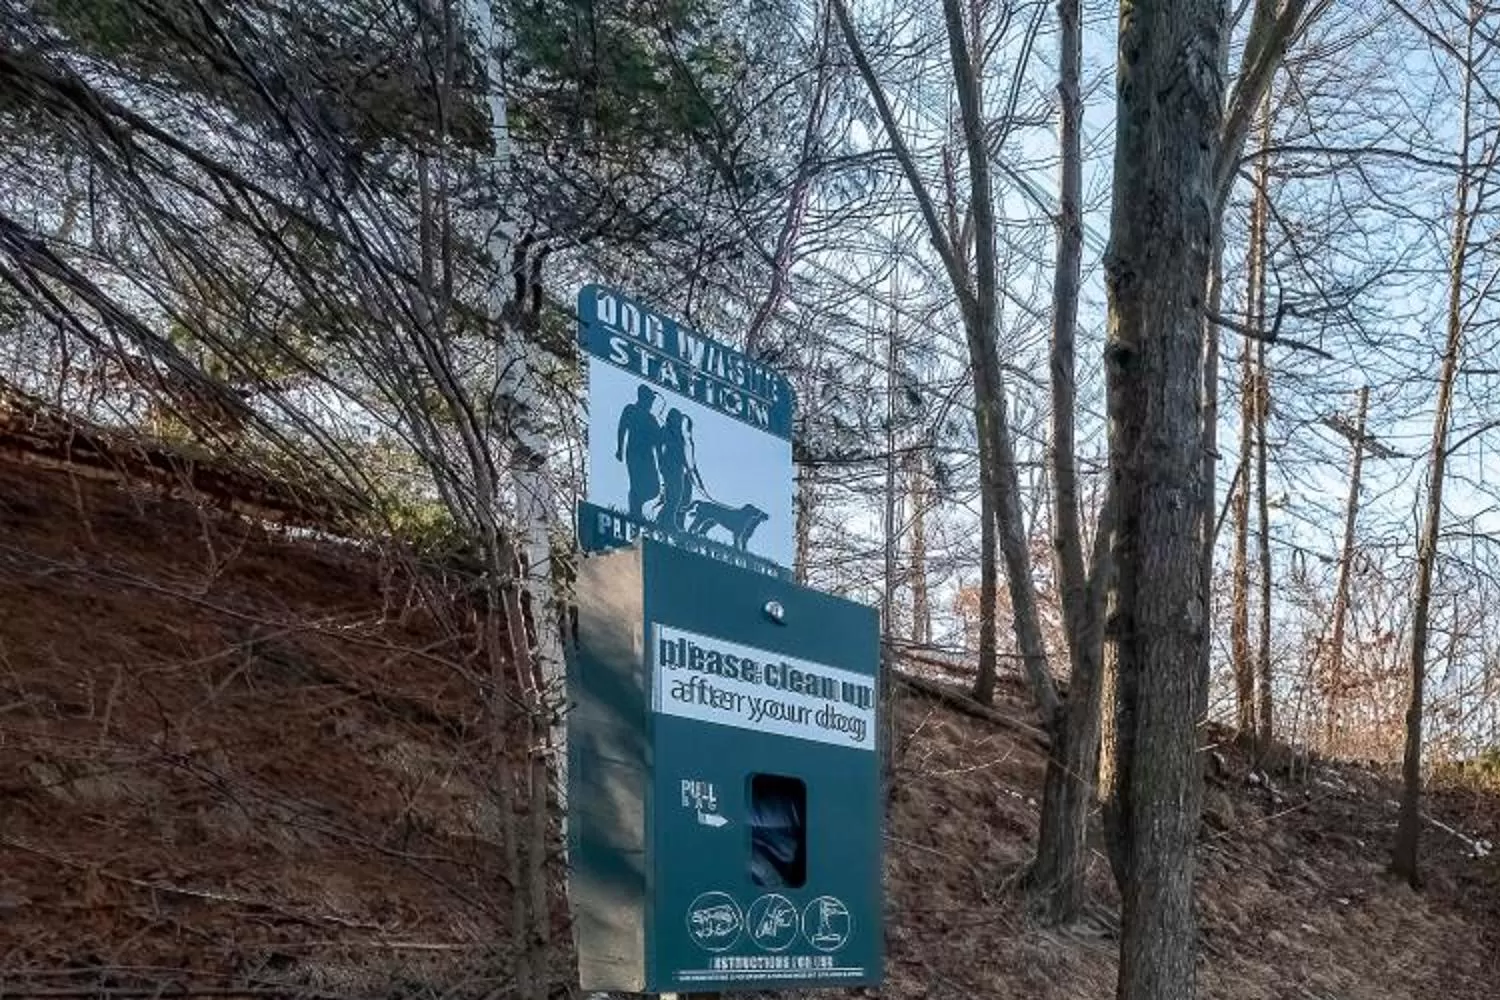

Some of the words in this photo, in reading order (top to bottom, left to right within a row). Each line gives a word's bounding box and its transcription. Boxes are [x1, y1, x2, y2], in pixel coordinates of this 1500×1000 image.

[610, 337, 770, 425] STATION
[660, 638, 755, 682] please
[764, 662, 838, 700] clean
[842, 682, 874, 710] up
[671, 676, 745, 713] after
[748, 695, 812, 723] your
[815, 703, 867, 742] dog
